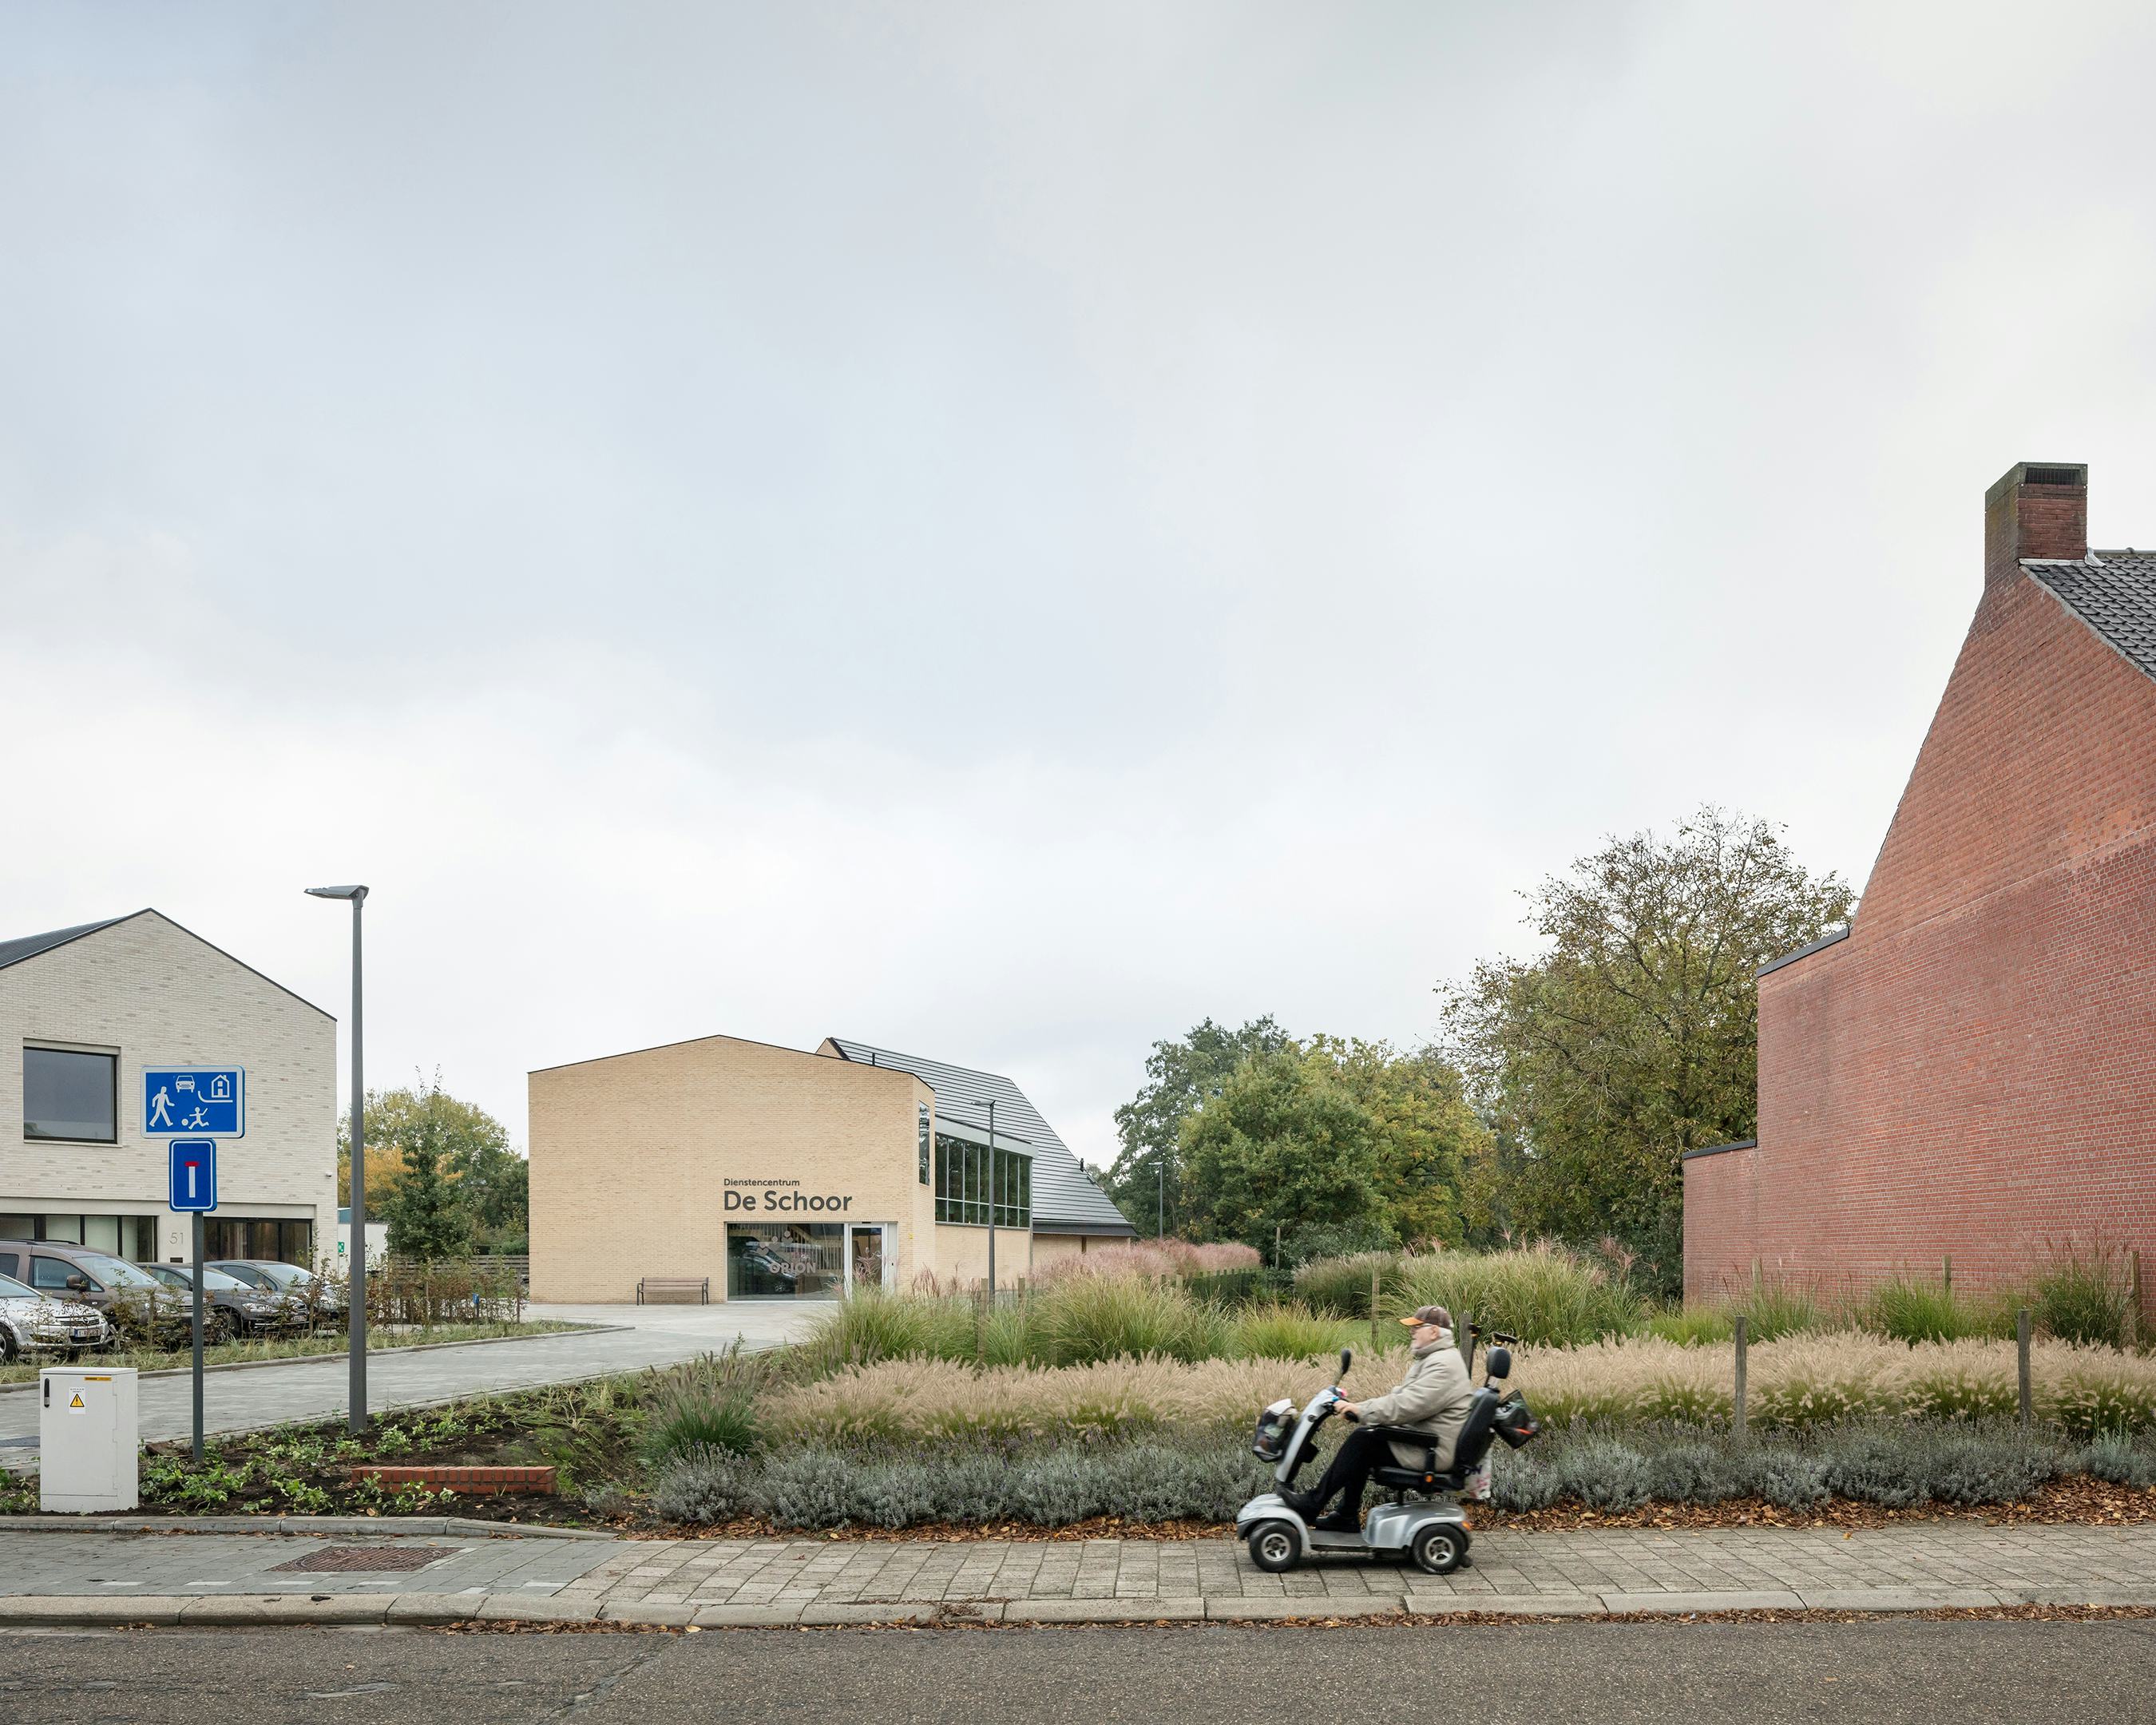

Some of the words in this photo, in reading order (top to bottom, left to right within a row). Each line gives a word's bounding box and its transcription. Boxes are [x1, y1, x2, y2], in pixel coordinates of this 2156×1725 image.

[724, 1190, 756, 1211] De
[764, 1190, 853, 1211] Schoor
[169, 1232, 184, 1244] 51
[769, 1262, 816, 1274] ORION
